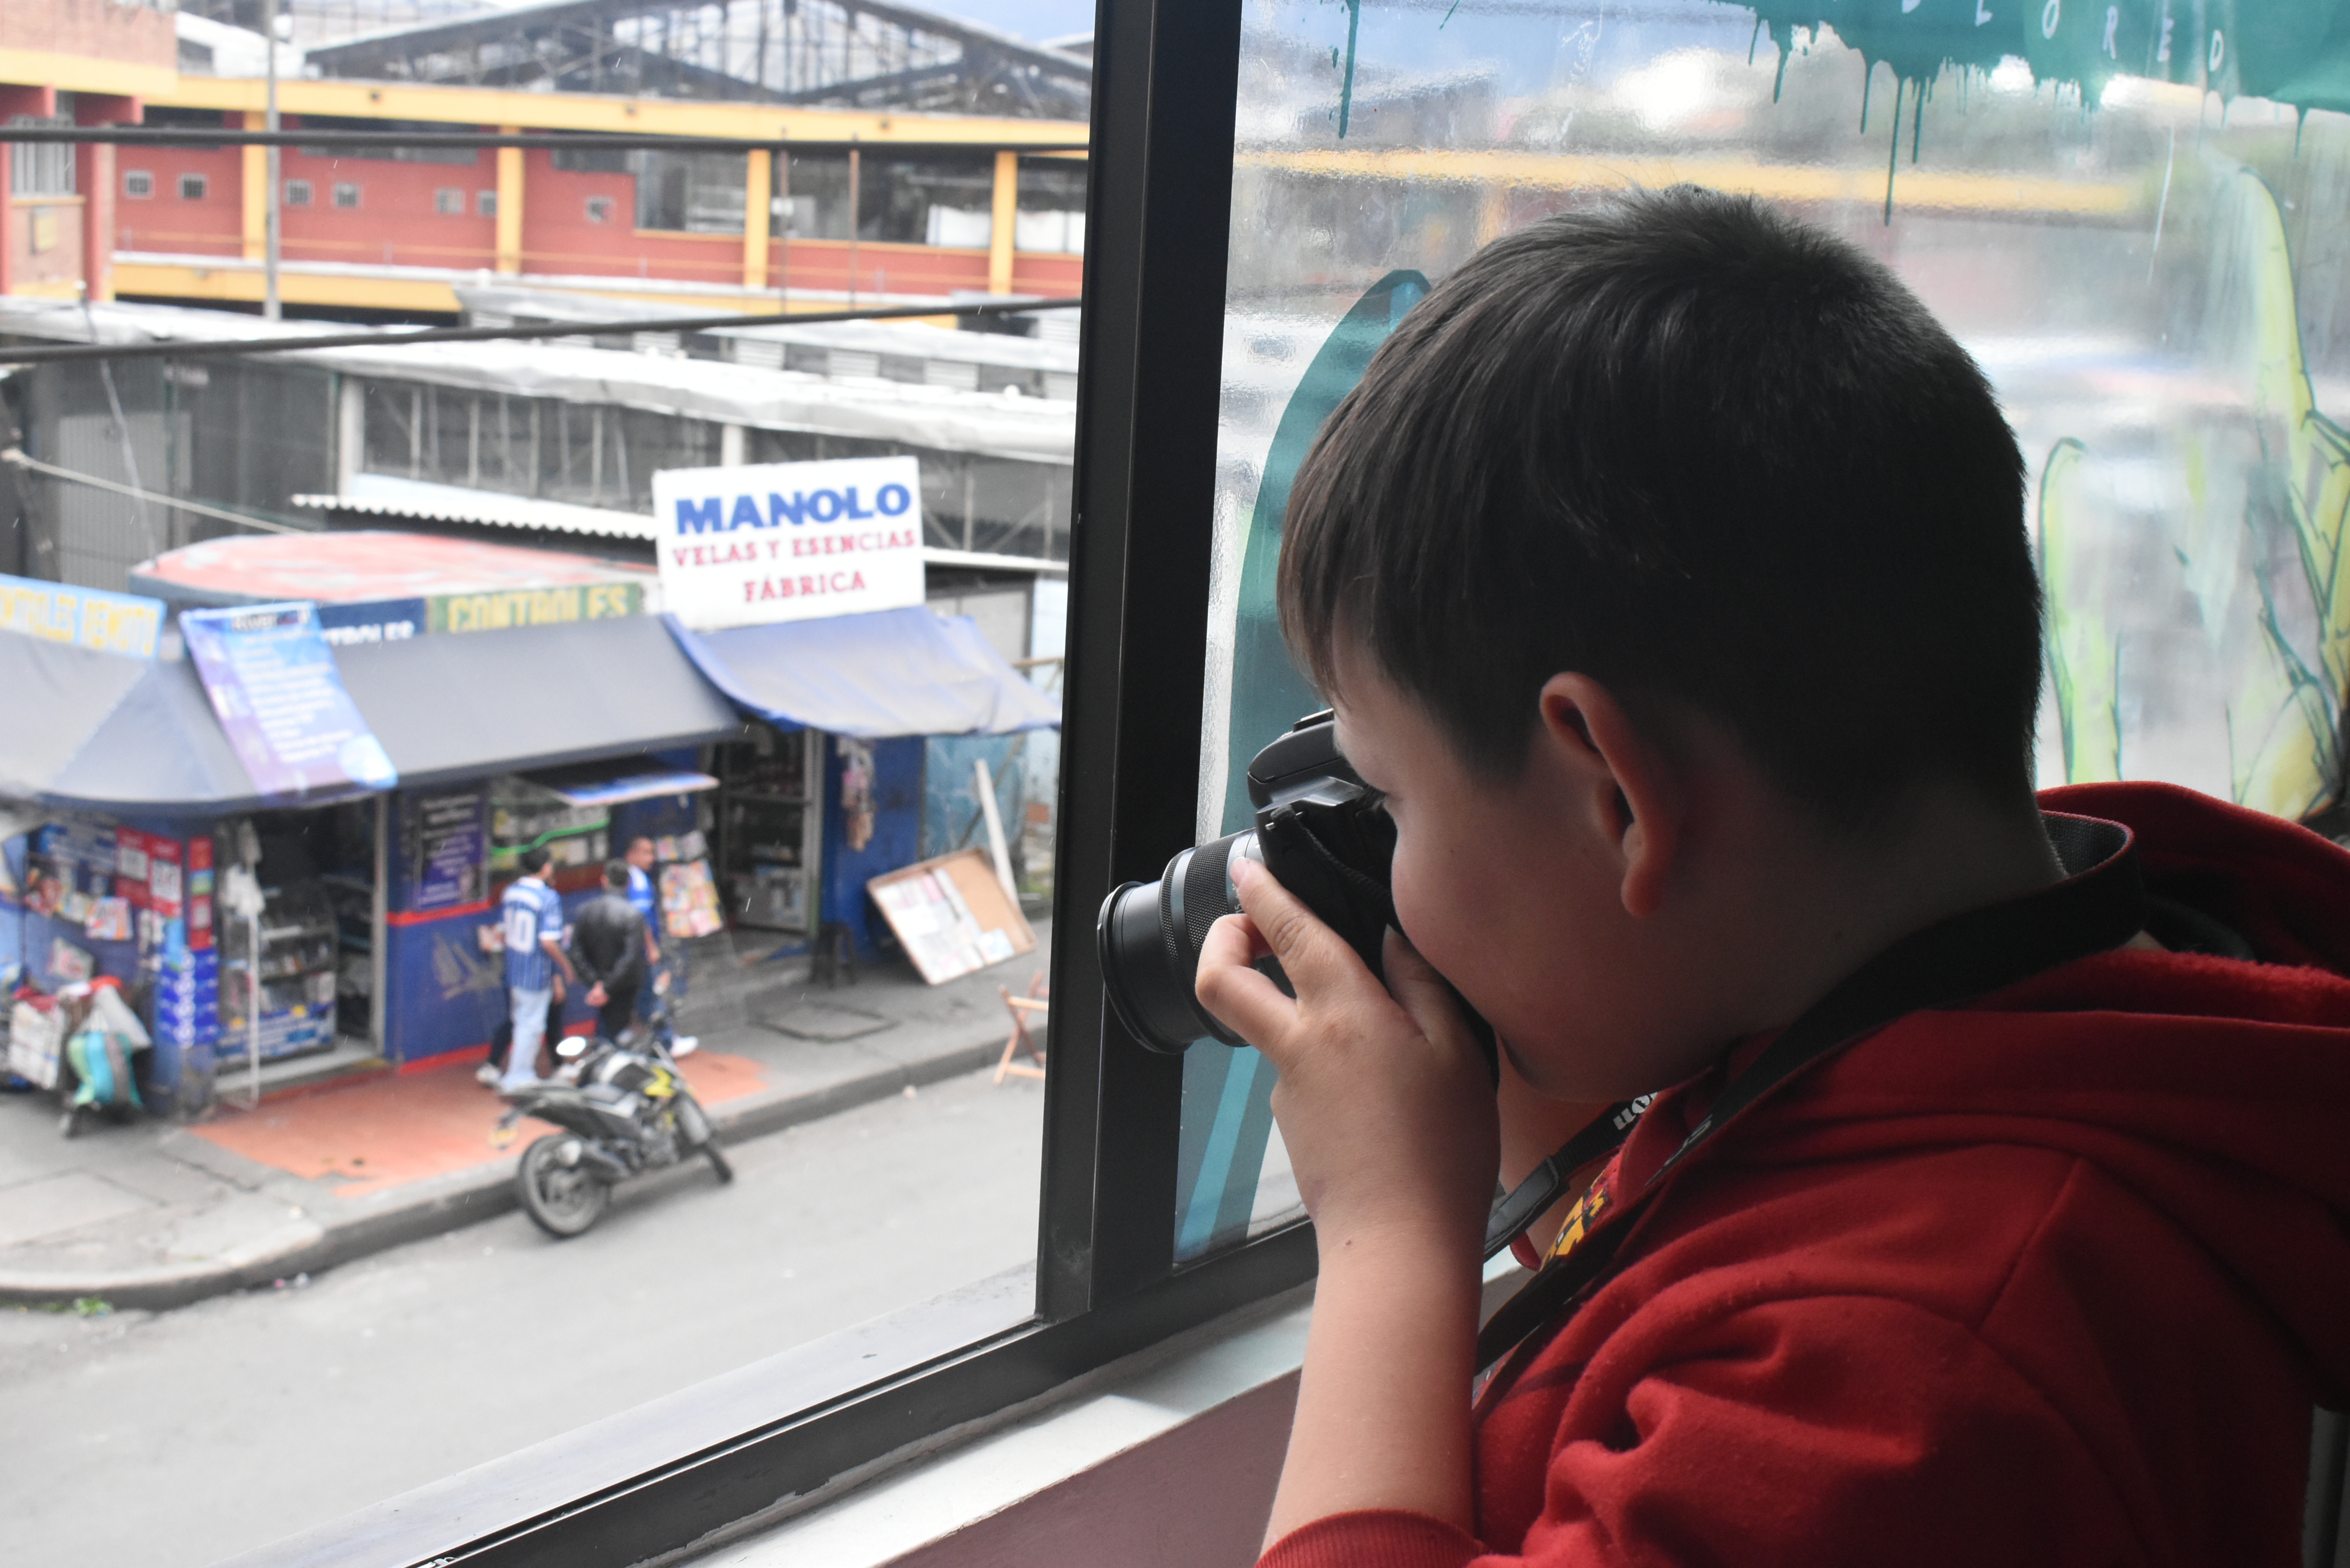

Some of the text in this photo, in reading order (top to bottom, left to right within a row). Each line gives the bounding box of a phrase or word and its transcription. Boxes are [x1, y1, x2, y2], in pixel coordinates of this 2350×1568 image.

[676, 483, 911, 534] MANOLO
[674, 529, 915, 567] VELAS Y ESENCIAS
